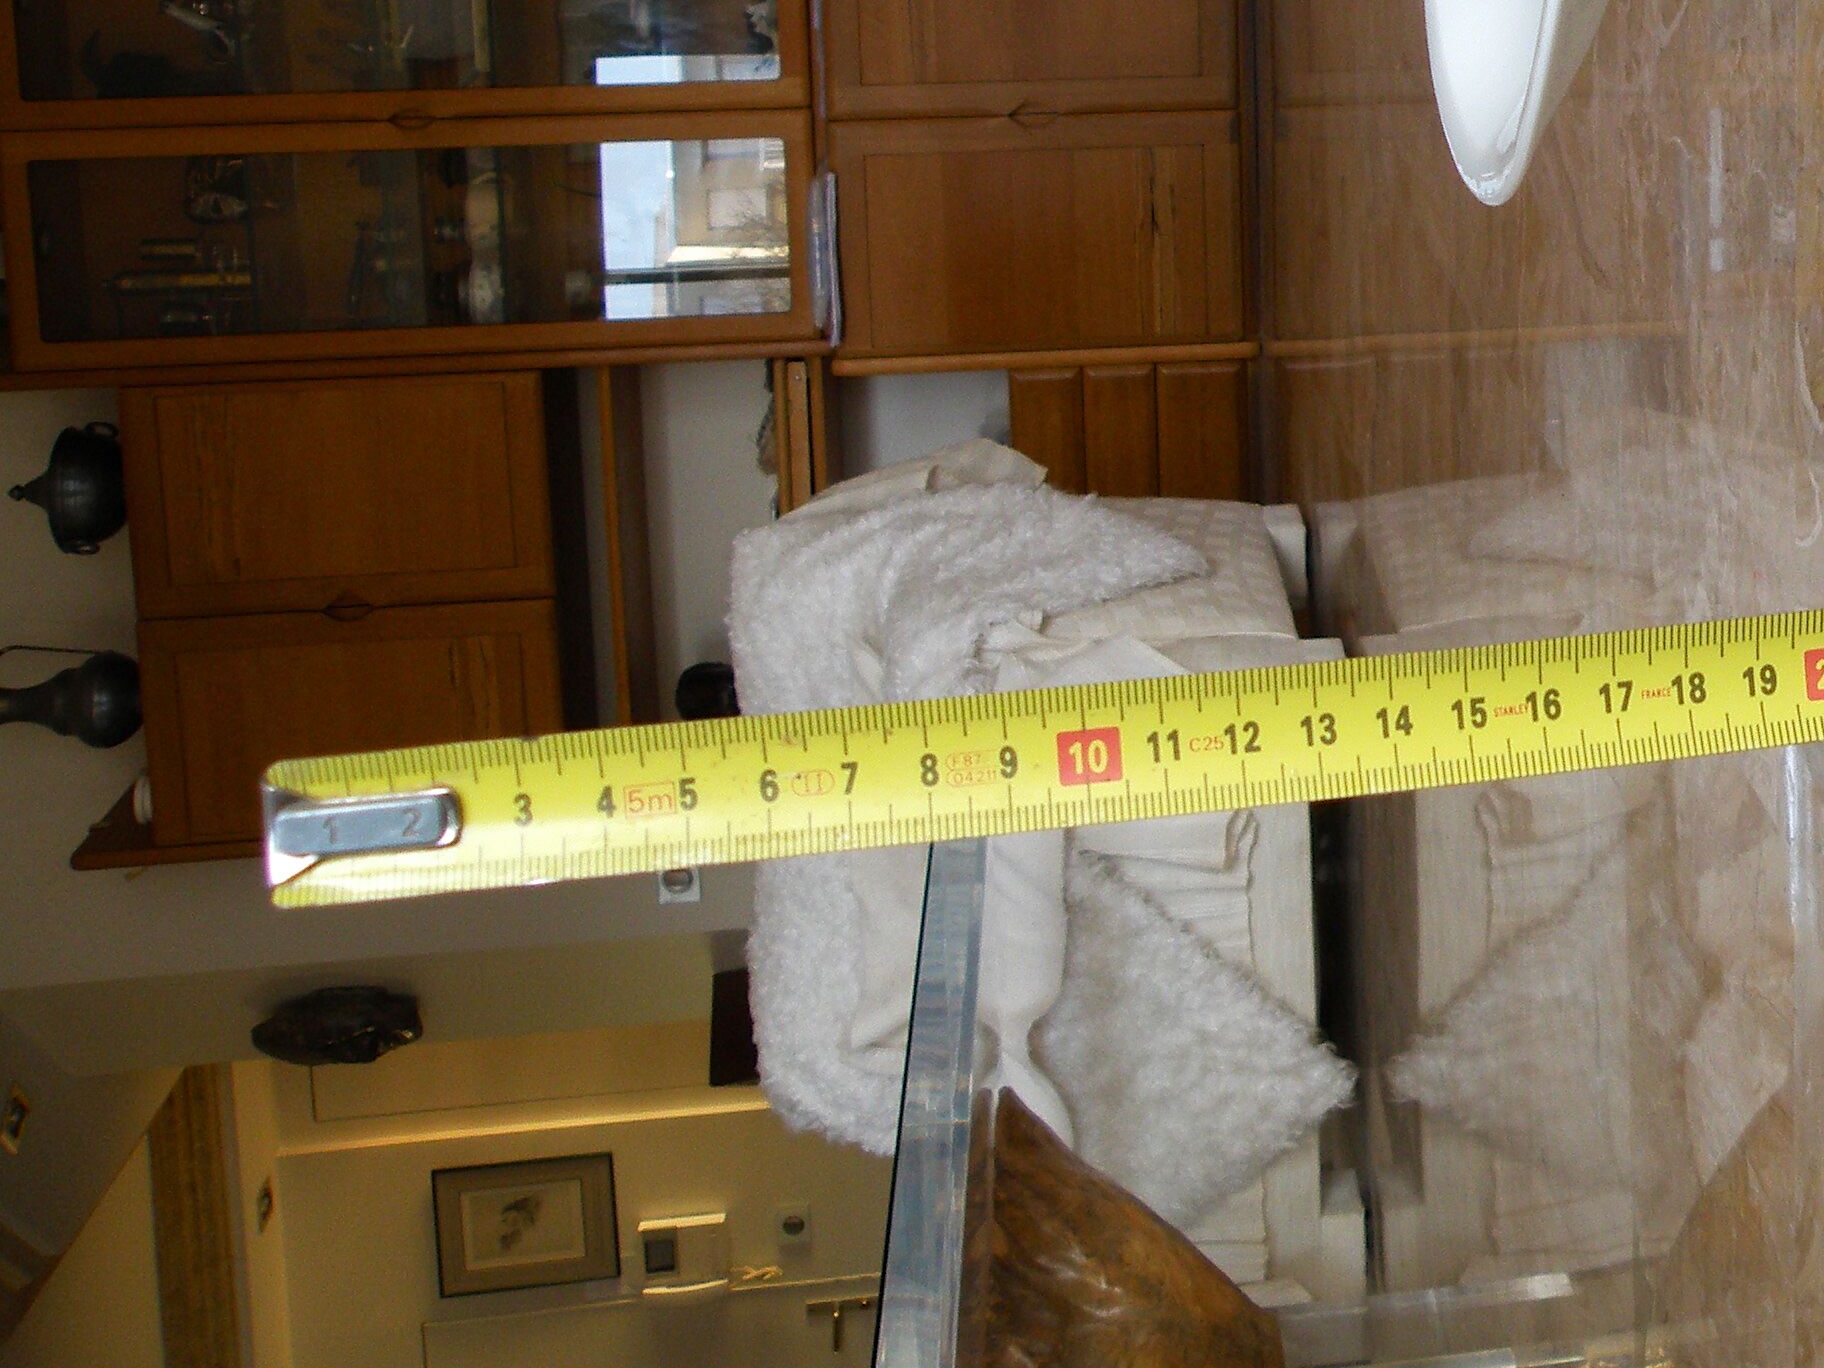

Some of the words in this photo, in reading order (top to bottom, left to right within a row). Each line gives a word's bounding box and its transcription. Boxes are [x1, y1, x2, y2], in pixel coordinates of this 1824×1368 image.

[1641, 687, 1672, 700] FRANCE
[1493, 703, 1529, 719] STANLEY
[1189, 735, 1224, 752] C25
[323, 816, 340, 844] 1
[402, 808, 422, 837] 2
[514, 793, 533, 826] 3
[597, 785, 616, 818] 4
[679, 777, 698, 810] 5
[760, 769, 780, 802] 6
[841, 762, 858, 795] 7
[919, 753, 938, 786] 8
[999, 745, 1018, 779] 9
[1069, 739, 1108, 774] 10
[1147, 729, 1181, 763] 11
[1224, 720, 1261, 754] 12
[1300, 713, 1338, 746] 13
[1376, 705, 1413, 738] 14
[1451, 697, 1488, 730] 15
[1525, 688, 1562, 722] 16
[1600, 680, 1633, 713] 17
[1671, 672, 1707, 706] 18
[1742, 664, 1778, 697] 19
[627, 789, 673, 813] 5m
